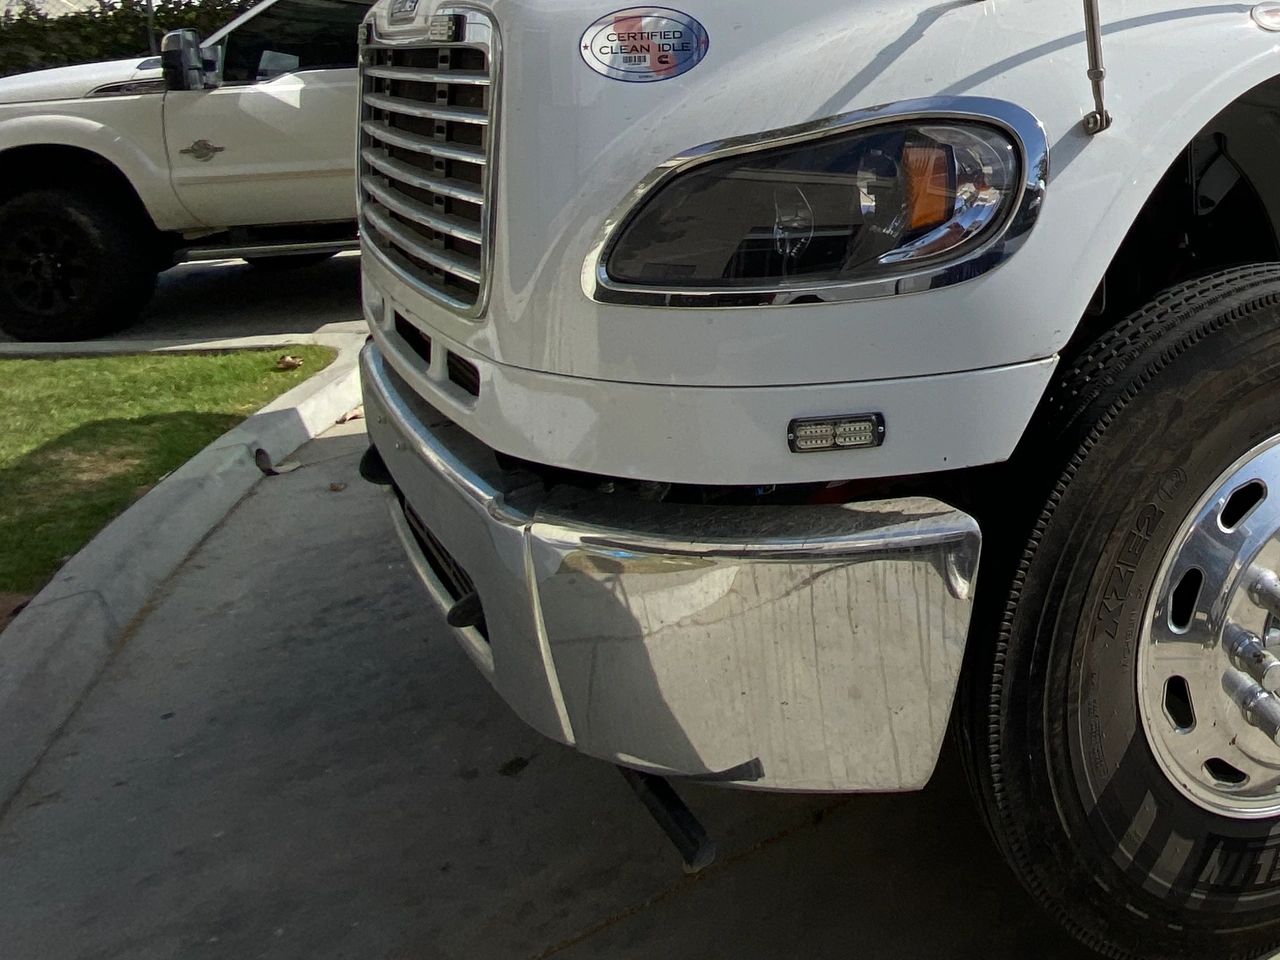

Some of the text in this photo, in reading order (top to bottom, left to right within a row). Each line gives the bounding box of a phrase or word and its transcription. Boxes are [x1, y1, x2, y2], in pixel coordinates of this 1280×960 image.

[606, 30, 683, 42] CERTIFIED
[599, 42, 691, 55] CLEAN IDLE
